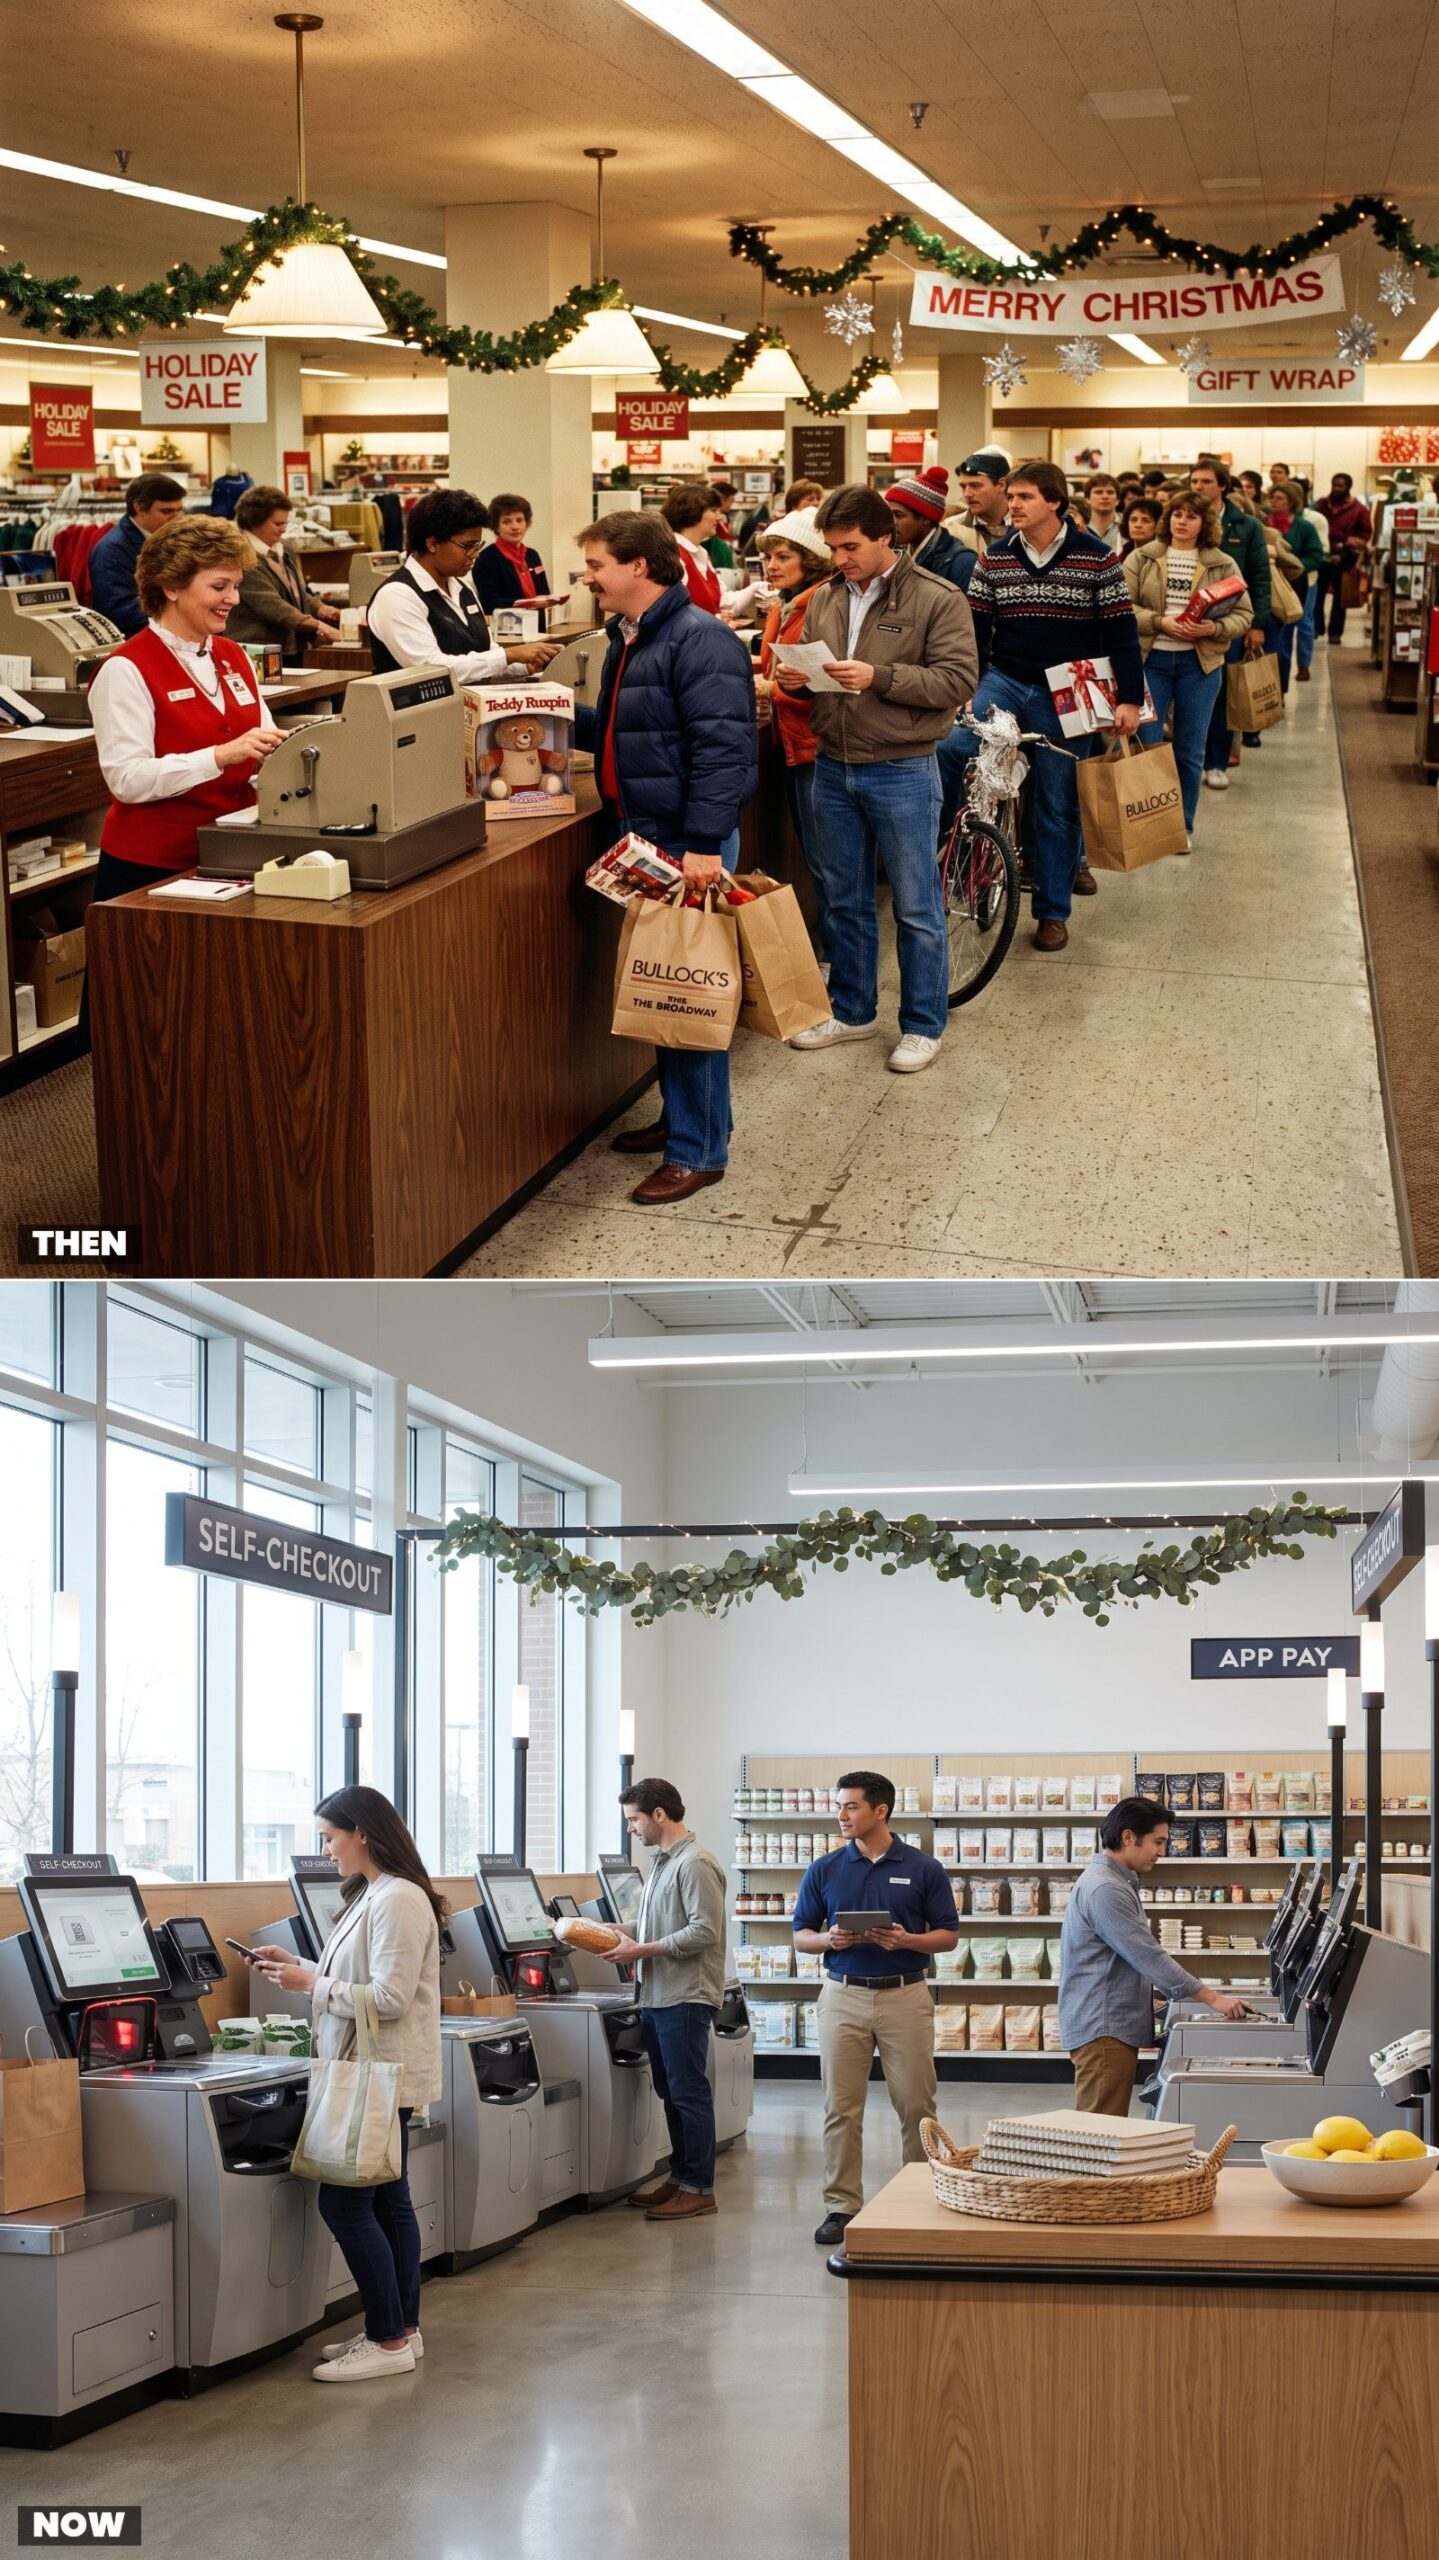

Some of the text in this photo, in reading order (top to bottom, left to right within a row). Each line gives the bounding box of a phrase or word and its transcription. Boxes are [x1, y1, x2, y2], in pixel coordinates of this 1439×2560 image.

[928, 271, 1324, 322] MERRY CHRISTMAS
[145, 353, 258, 379] HOLIDAY
[1196, 369, 1356, 391] GIFT WRAP
[164, 382, 242, 410] SALE
[34, 403, 90, 421] HOLIDAY
[618, 401, 686, 415] HOLIDAY
[46, 422, 81, 437] SALE
[629, 416, 675, 431] SALE
[485, 697, 523, 712] Teddy
[525, 696, 570, 711] Ruxpin
[1125, 788, 1179, 818] BULLOCK'S
[632, 960, 729, 987] BULLOCK'S
[633, 998, 717, 1017] THE BROADWAY
[199, 1518, 382, 1595] SELF-CHECKOUT
[1354, 1507, 1400, 1595] SELF-CHECKOUT
[1218, 1647, 1332, 1668] APP PAY
[40, 1860, 102, 1870] SELF-CHECKOUT
